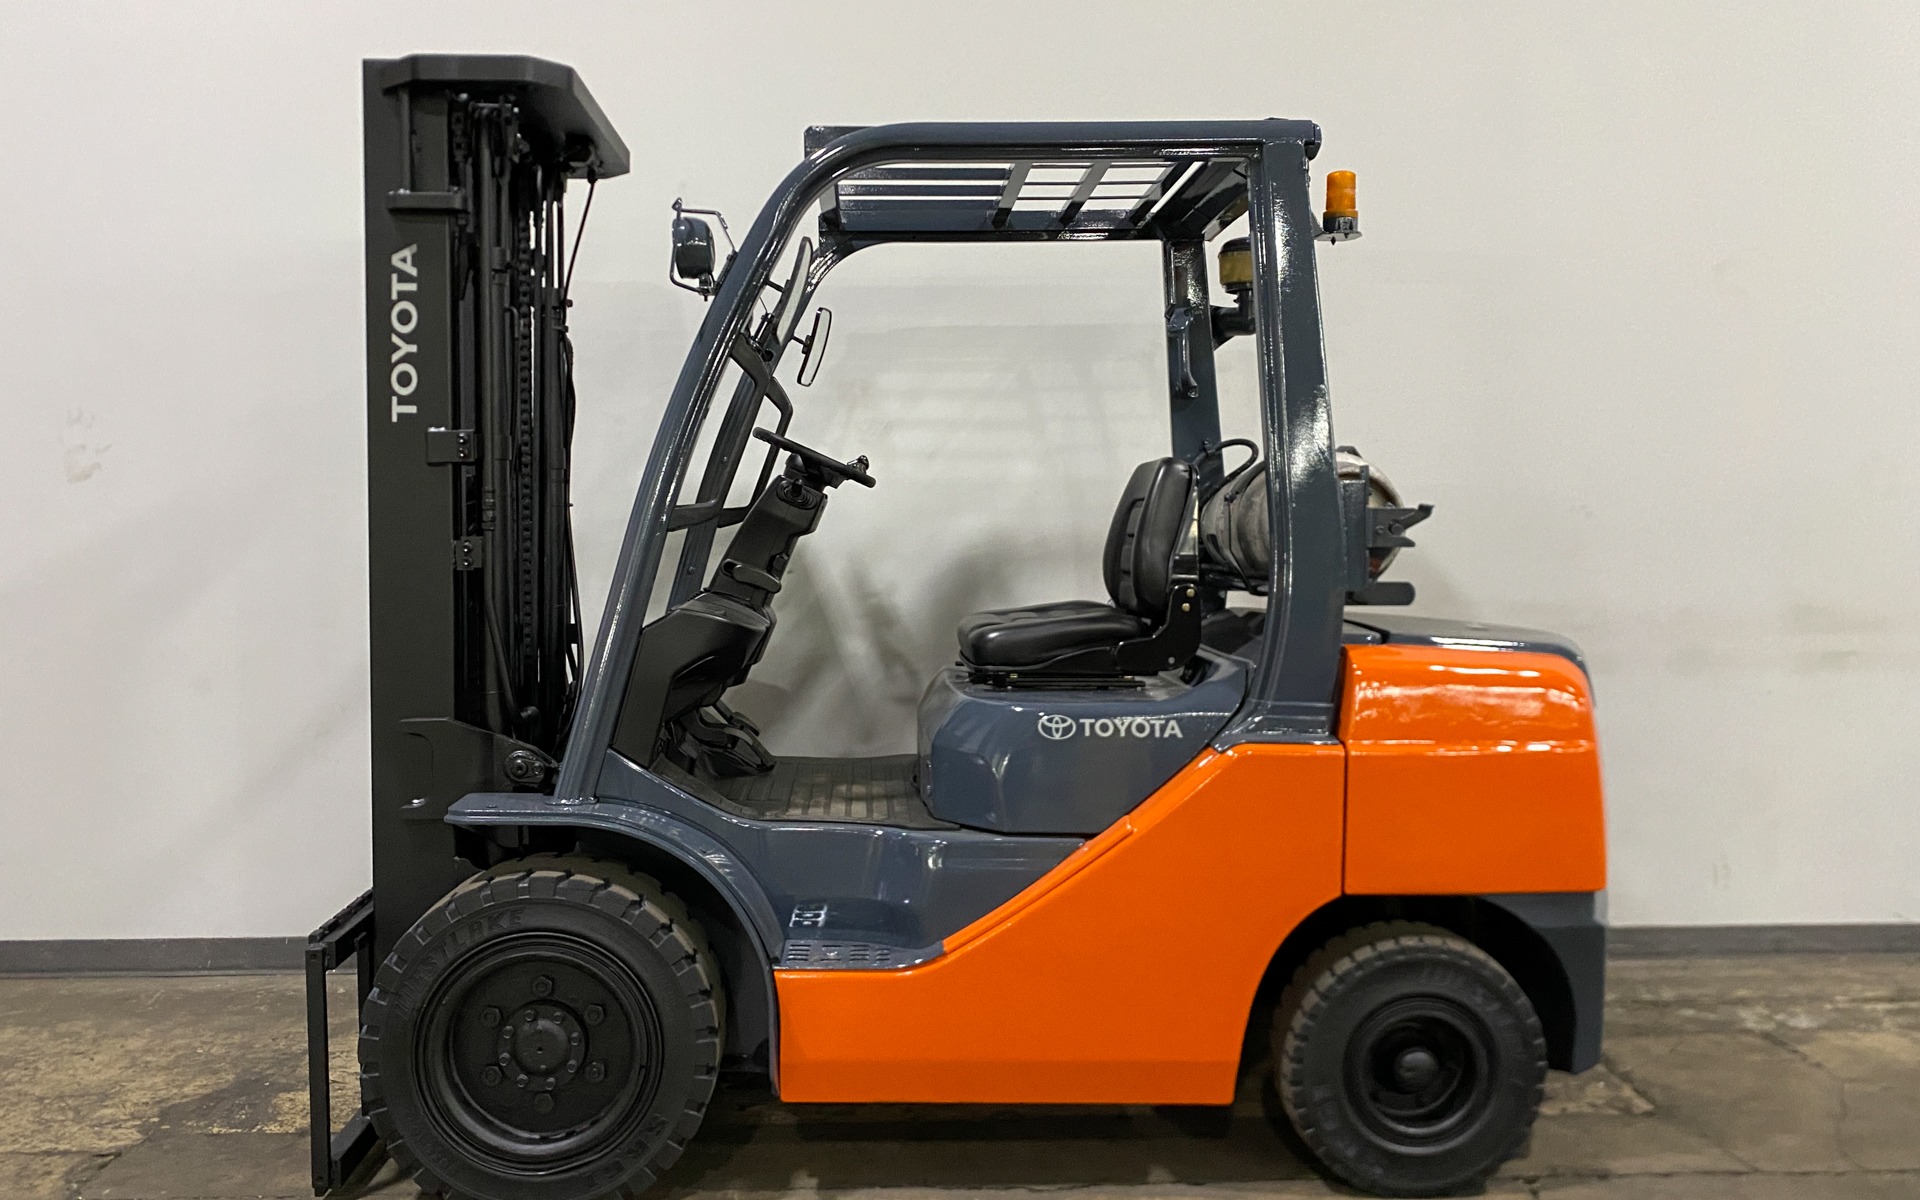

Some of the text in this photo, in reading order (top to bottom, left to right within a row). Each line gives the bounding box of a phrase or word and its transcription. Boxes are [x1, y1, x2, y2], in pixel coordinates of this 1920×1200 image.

[390, 243, 418, 423] TOYOTA
[1079, 718, 1183, 739] TOYOTA
[395, 906, 526, 1021] WESTLAKE
